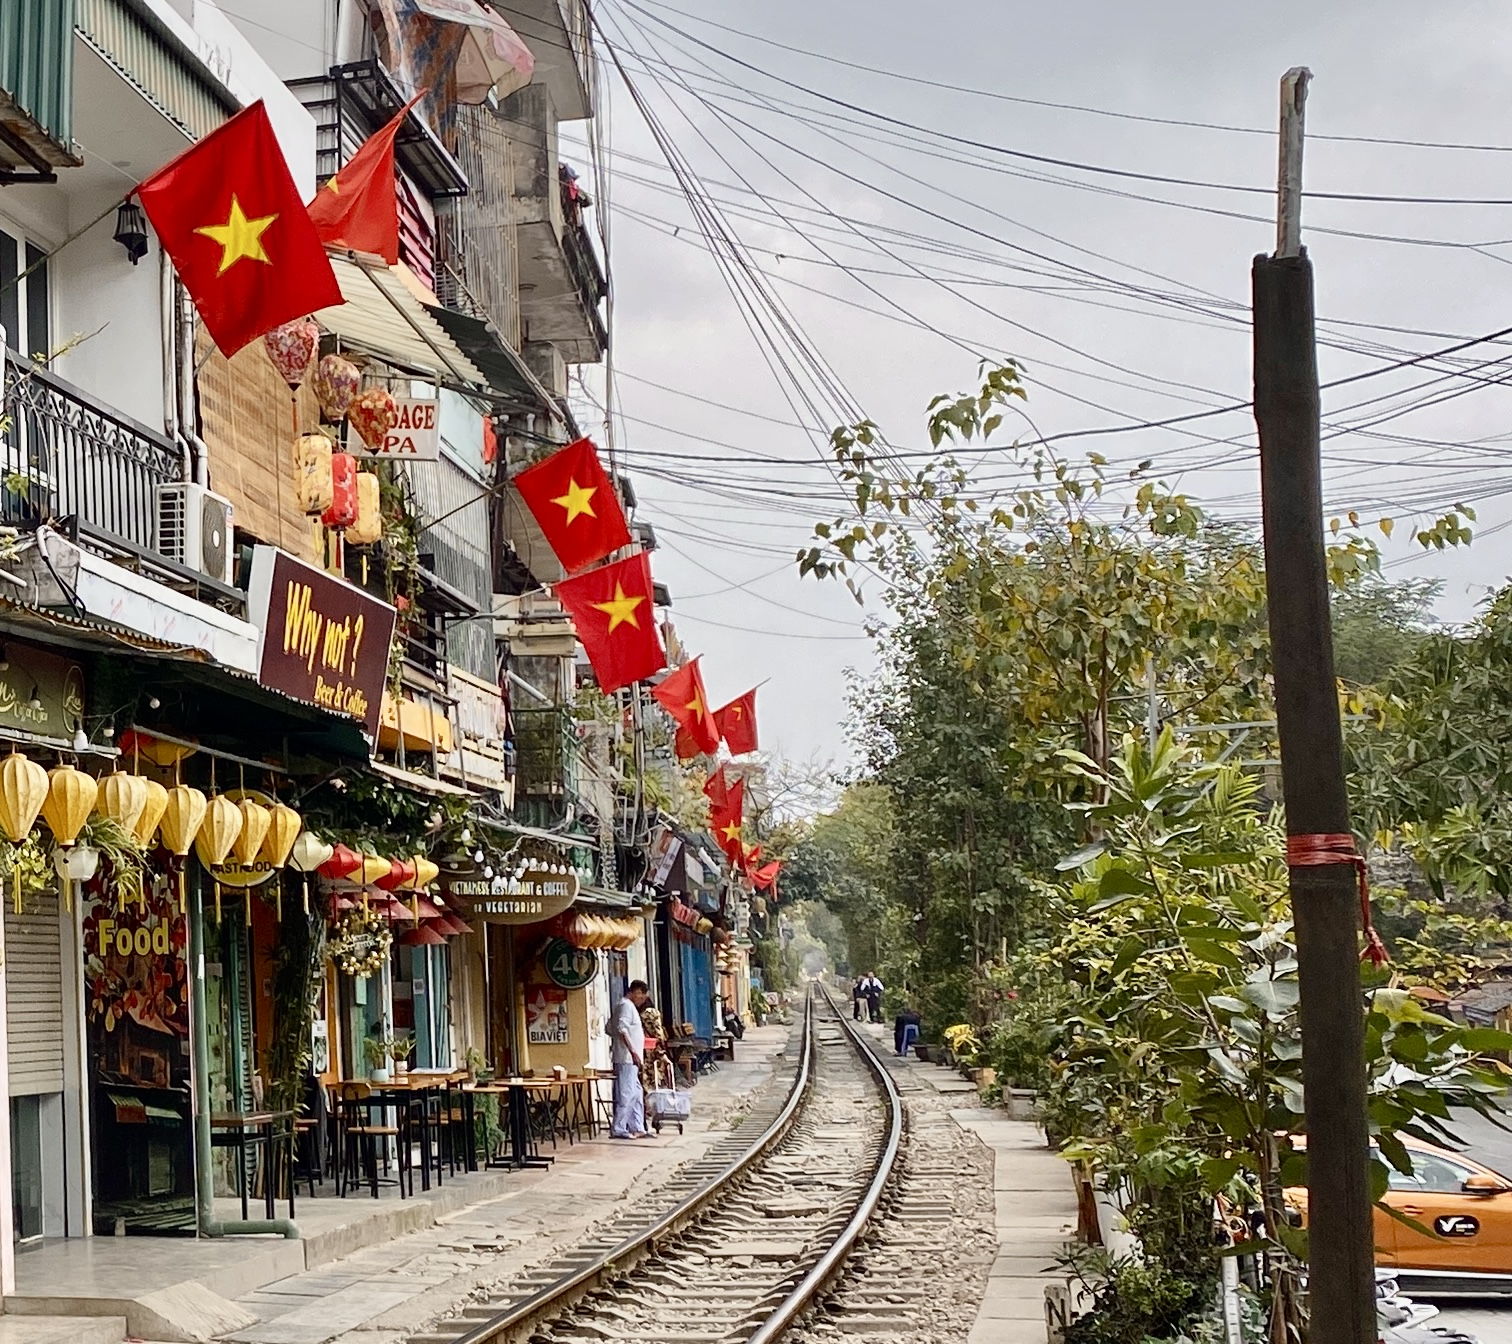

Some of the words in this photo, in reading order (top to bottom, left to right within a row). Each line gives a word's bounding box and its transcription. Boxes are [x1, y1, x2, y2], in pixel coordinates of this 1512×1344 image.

[383, 436, 417, 454] PA
[284, 580, 323, 675] Why
[314, 674, 336, 706] Beer
[342, 686, 368, 718] Coffee
[543, 881, 569, 896] COFFEE
[485, 901, 543, 914] VEGETARIAN
[98, 917, 170, 956] Food
